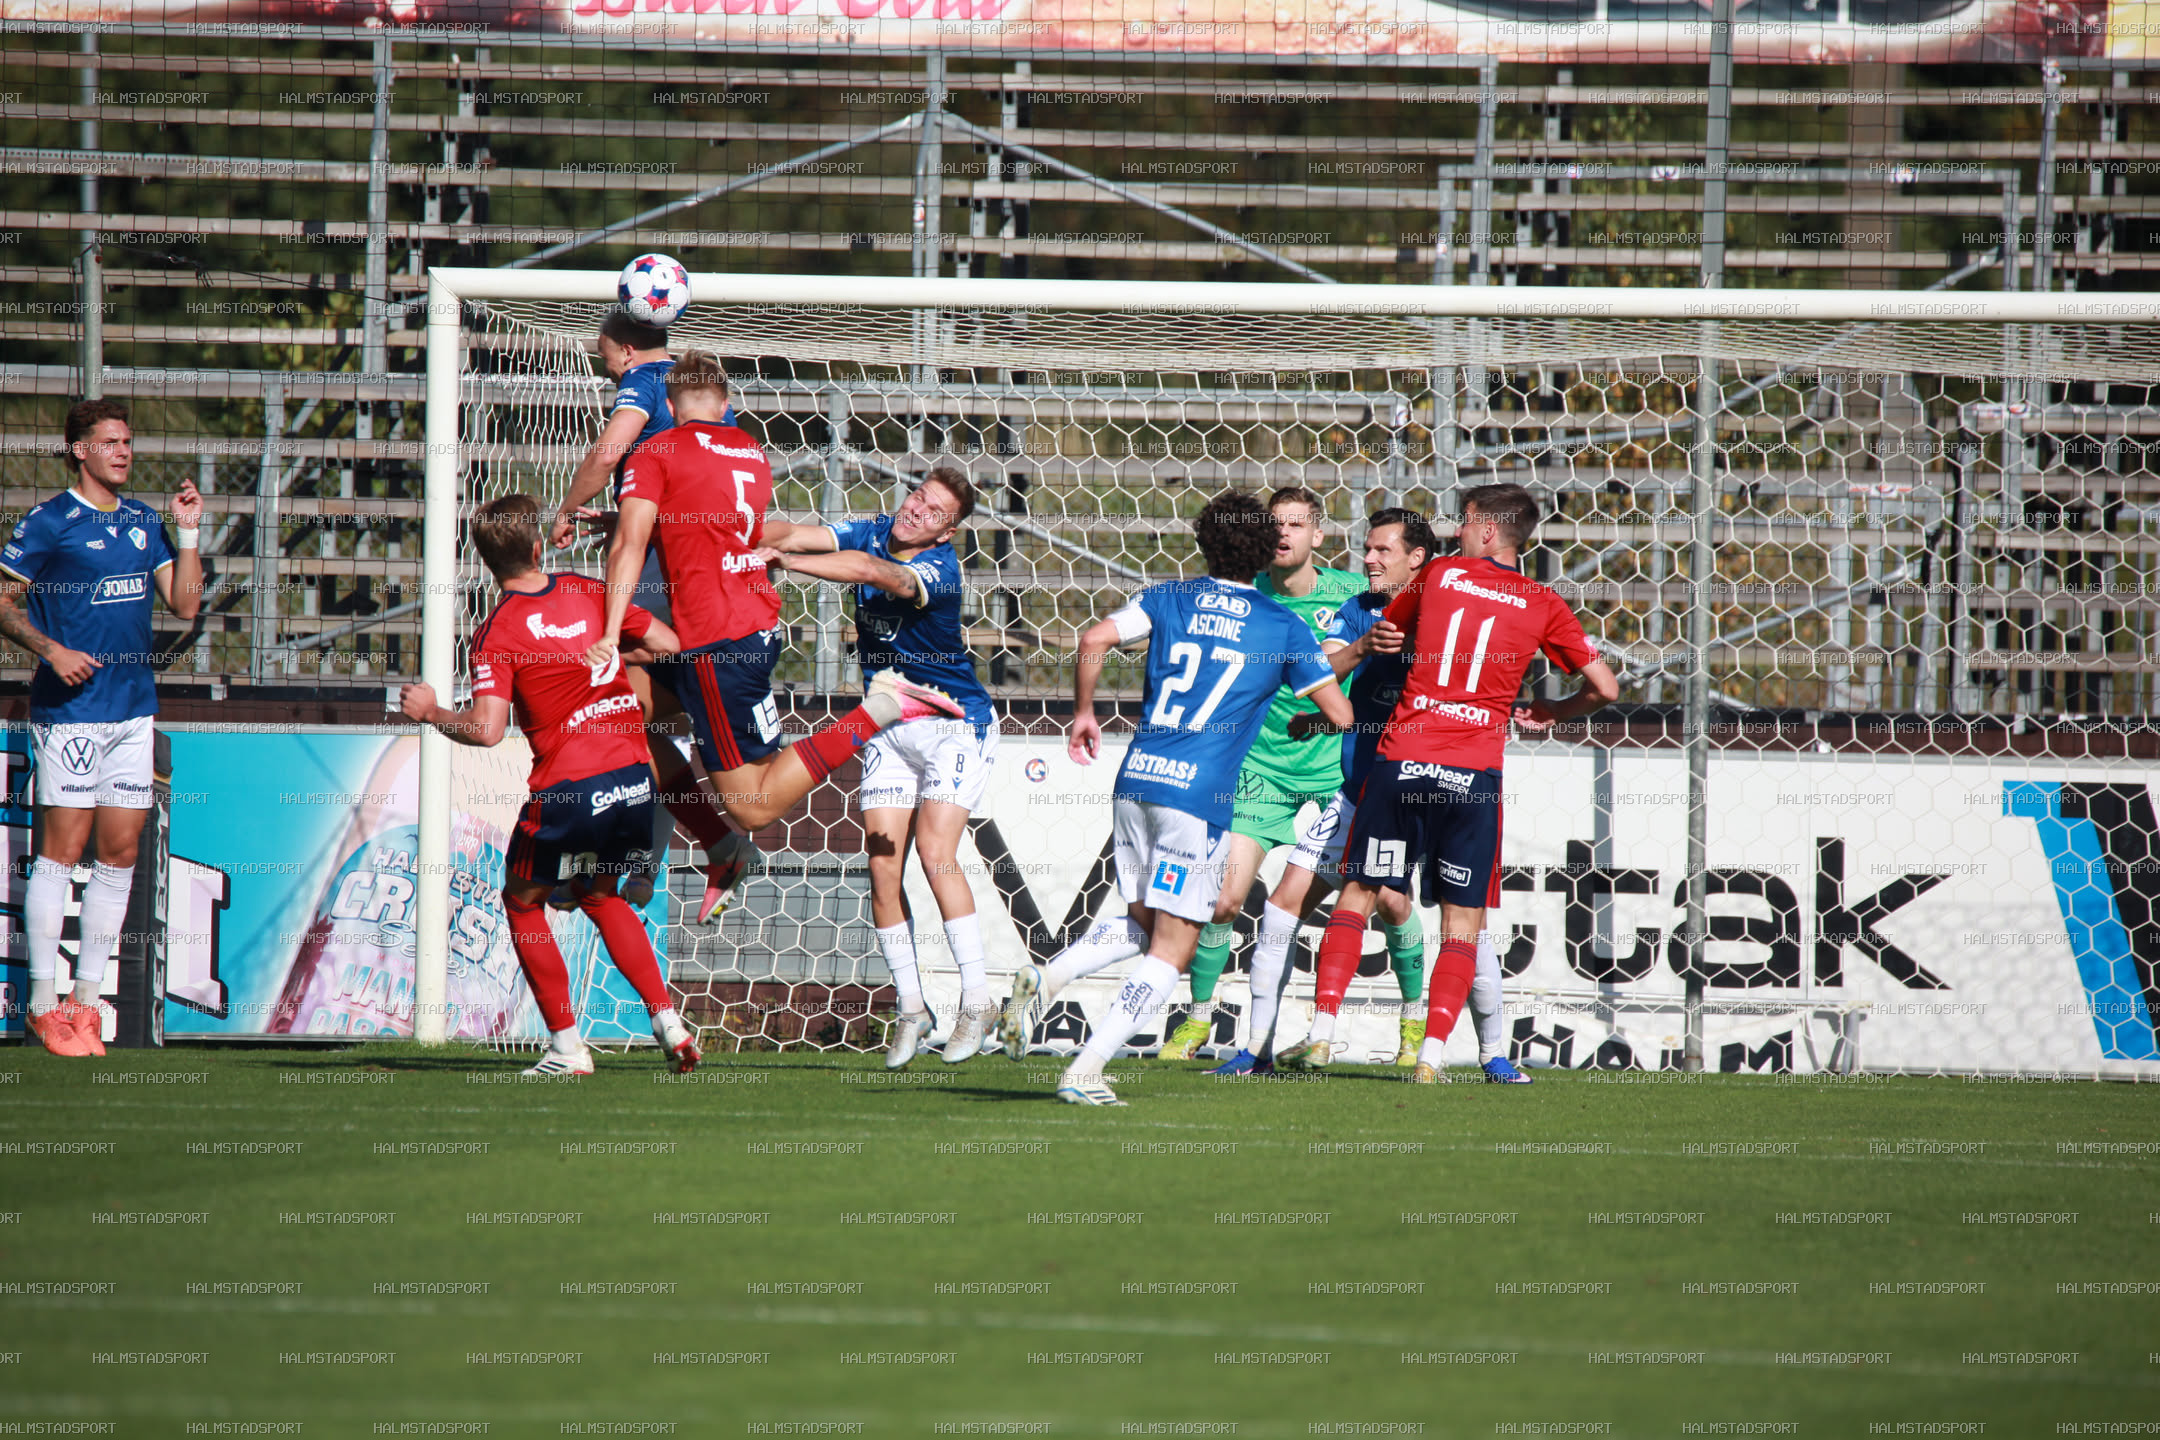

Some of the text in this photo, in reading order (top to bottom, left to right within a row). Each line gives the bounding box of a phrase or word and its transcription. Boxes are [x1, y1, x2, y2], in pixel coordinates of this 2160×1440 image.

[732, 470, 756, 545] 5
[722, 551, 767, 574] dyna
[103, 578, 144, 598] JONAB
[1444, 577, 1527, 609] Fellessons
[1200, 593, 1247, 615] EAB
[1186, 613, 1246, 642] ASCONE
[1437, 606, 1496, 693] 11
[1150, 641, 1246, 732] 27
[955, 753, 965, 773] 8
[1126, 747, 1190, 781] ÖSTRAS
[1400, 760, 1475, 787] GoAhead
[113, 781, 149, 793] villalivet
[591, 776, 651, 808] GoAhead
[1437, 780, 1470, 795] SWEDEN
